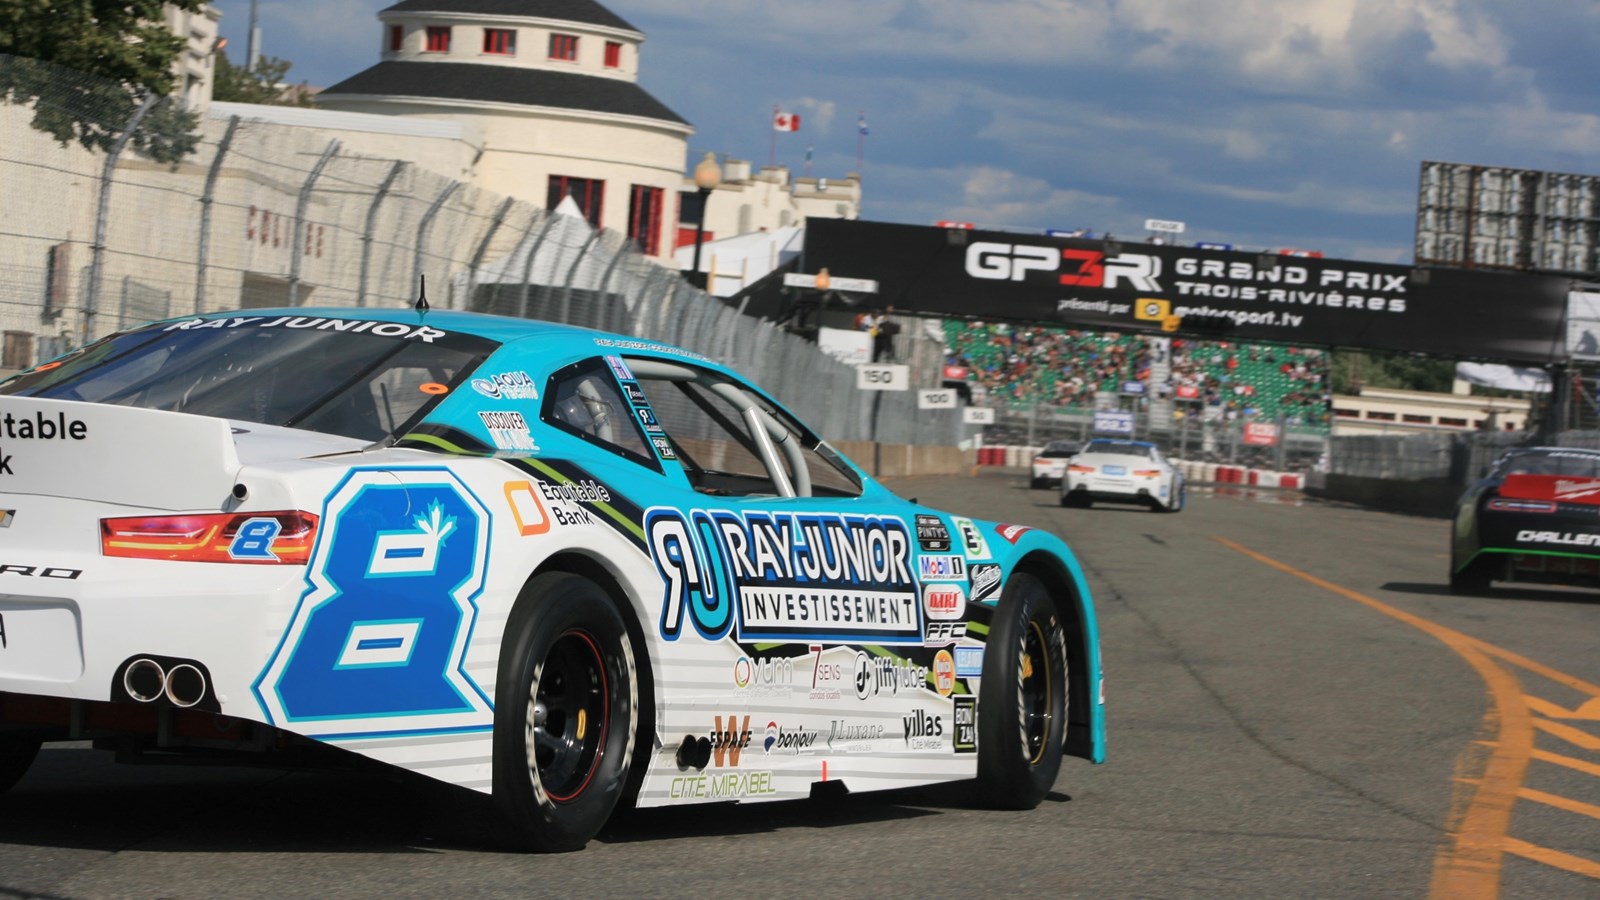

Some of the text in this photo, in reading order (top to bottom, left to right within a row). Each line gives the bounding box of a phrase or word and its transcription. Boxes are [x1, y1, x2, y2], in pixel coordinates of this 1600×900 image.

[1320, 267, 1407, 292] PRIX
[1110, 303, 1130, 315] par
[163, 316, 446, 343] RAY JUNIOR
[492, 371, 535, 387] AQUA
[863, 370, 893, 384] 150
[925, 393, 949, 404] 100
[479, 411, 528, 430] DISCOVER
[538, 480, 610, 505] Equitable
[552, 506, 594, 525] Bank
[227, 518, 282, 562] 8
[801, 525, 911, 584] JUNIOR
[921, 556, 962, 575] Mobil 1
[258, 472, 488, 730] 8
[744, 592, 912, 625] INVESTISSEMENT
[926, 624, 966, 639] PFC
[811, 646, 841, 690] 7 SENS
[711, 731, 753, 749] ESPACE
[714, 715, 750, 768] W
[777, 725, 818, 755] bonjour
[836, 720, 884, 740] Luxane
[903, 709, 943, 749] villas
[670, 771, 776, 799] CITÉ MIRABEL
